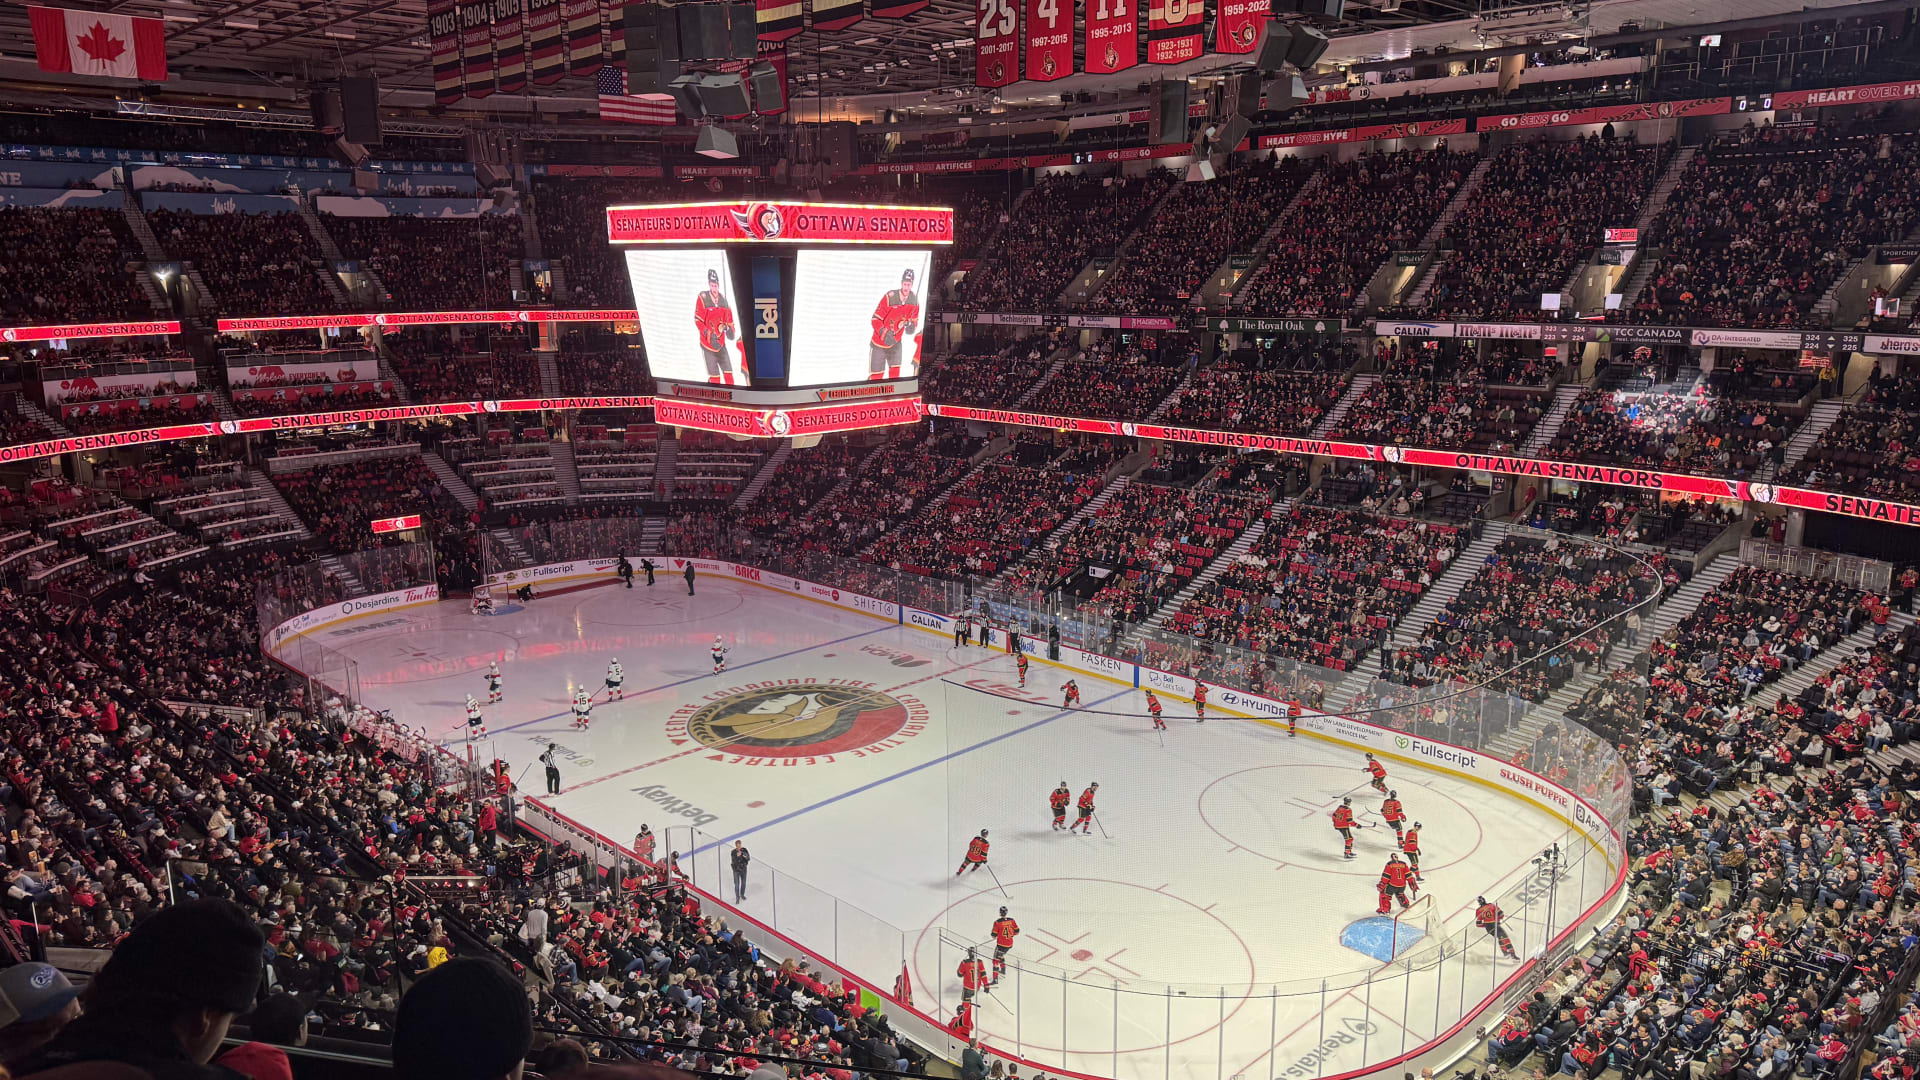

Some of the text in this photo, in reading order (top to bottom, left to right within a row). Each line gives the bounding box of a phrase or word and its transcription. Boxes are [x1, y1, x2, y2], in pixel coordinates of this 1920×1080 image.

[462, 4, 488, 27] 1904
[1037, 0, 1059, 28] 4
[1095, 0, 1127, 20] 11
[1223, 1, 1271, 16] 1959-2022
[430, 12, 456, 36] 1903
[979, 0, 1016, 38] 25
[1090, 23, 1133, 38] 1995-2013
[980, 41, 1015, 54] 2001-2017
[1031, 33, 1068, 47] 1997-2015
[1156, 38, 1194, 51] 1923-1931
[1156, 47, 1193, 60] 1932-1933
[1325, 88, 1351, 102] BOX
[1807, 90, 1855, 104] HEART
[1858, 87, 1901, 99] OVER
[1501, 113, 1569, 127] GO SENS GO
[1266, 136, 1295, 146] HEART
[1322, 131, 1349, 142] HYPE
[1107, 151, 1119, 160] GO
[1139, 148, 1151, 157] GO
[681, 167, 708, 175] HEART
[731, 167, 753, 175] HYPE
[935, 161, 973, 170] ARTIFICES
[616, 214, 731, 232] SÉNATEURS D'OTTAWA
[796, 213, 946, 233] OTTAWA SENATORS
[296, 316, 350, 327] D'OTTAWA
[398, 312, 494, 323] OTTAWA SENATORS
[754, 297, 779, 339] Bell
[956, 313, 978, 323] MNP
[1136, 318, 1168, 326] MAGENTA
[53, 324, 168, 337] OTTAWA SENATORS
[1237, 319, 1305, 332] The Royal Oak
[1394, 326, 1430, 336] CALIAN
[1614, 327, 1682, 338] TCC CANADA
[540, 398, 601, 409] OTTAWA
[271, 405, 443, 429] SENATEURS D'OTTAWA
[660, 405, 751, 429] OTTAWA SENATORS
[796, 404, 913, 428] SÉNATEURS D'OTTAWA
[969, 408, 1078, 430] OTTAWA SENATORS
[1, 429, 160, 462] OTTAWA SENATORS
[1162, 427, 1333, 456] SENATEURS D'OTTAWA
[1455, 453, 1663, 488] OTTAWA SENATORS
[533, 564, 574, 577] Fullscript
[735, 565, 760, 582] BRICK
[404, 590, 423, 603] Tim
[811, 586, 831, 597] staples
[355, 594, 400, 611] Desjardins
[911, 613, 942, 630] CALIAN
[1081, 652, 1121, 671] FASKEN
[1163, 674, 1174, 683] Bell
[579, 697, 587, 705] 15
[665, 677, 878, 739] CENTRE CANADIAN TIRE
[727, 692, 930, 768] CANADIAN TIRE CENTRE
[1332, 719, 1346, 728] LAND
[1345, 722, 1384, 738] DEVELOPMENT
[1335, 727, 1358, 739] SERVICES
[1411, 741, 1477, 770] Fullscript
[1500, 768, 1533, 789] SLUSH
[629, 784, 719, 828] betway
